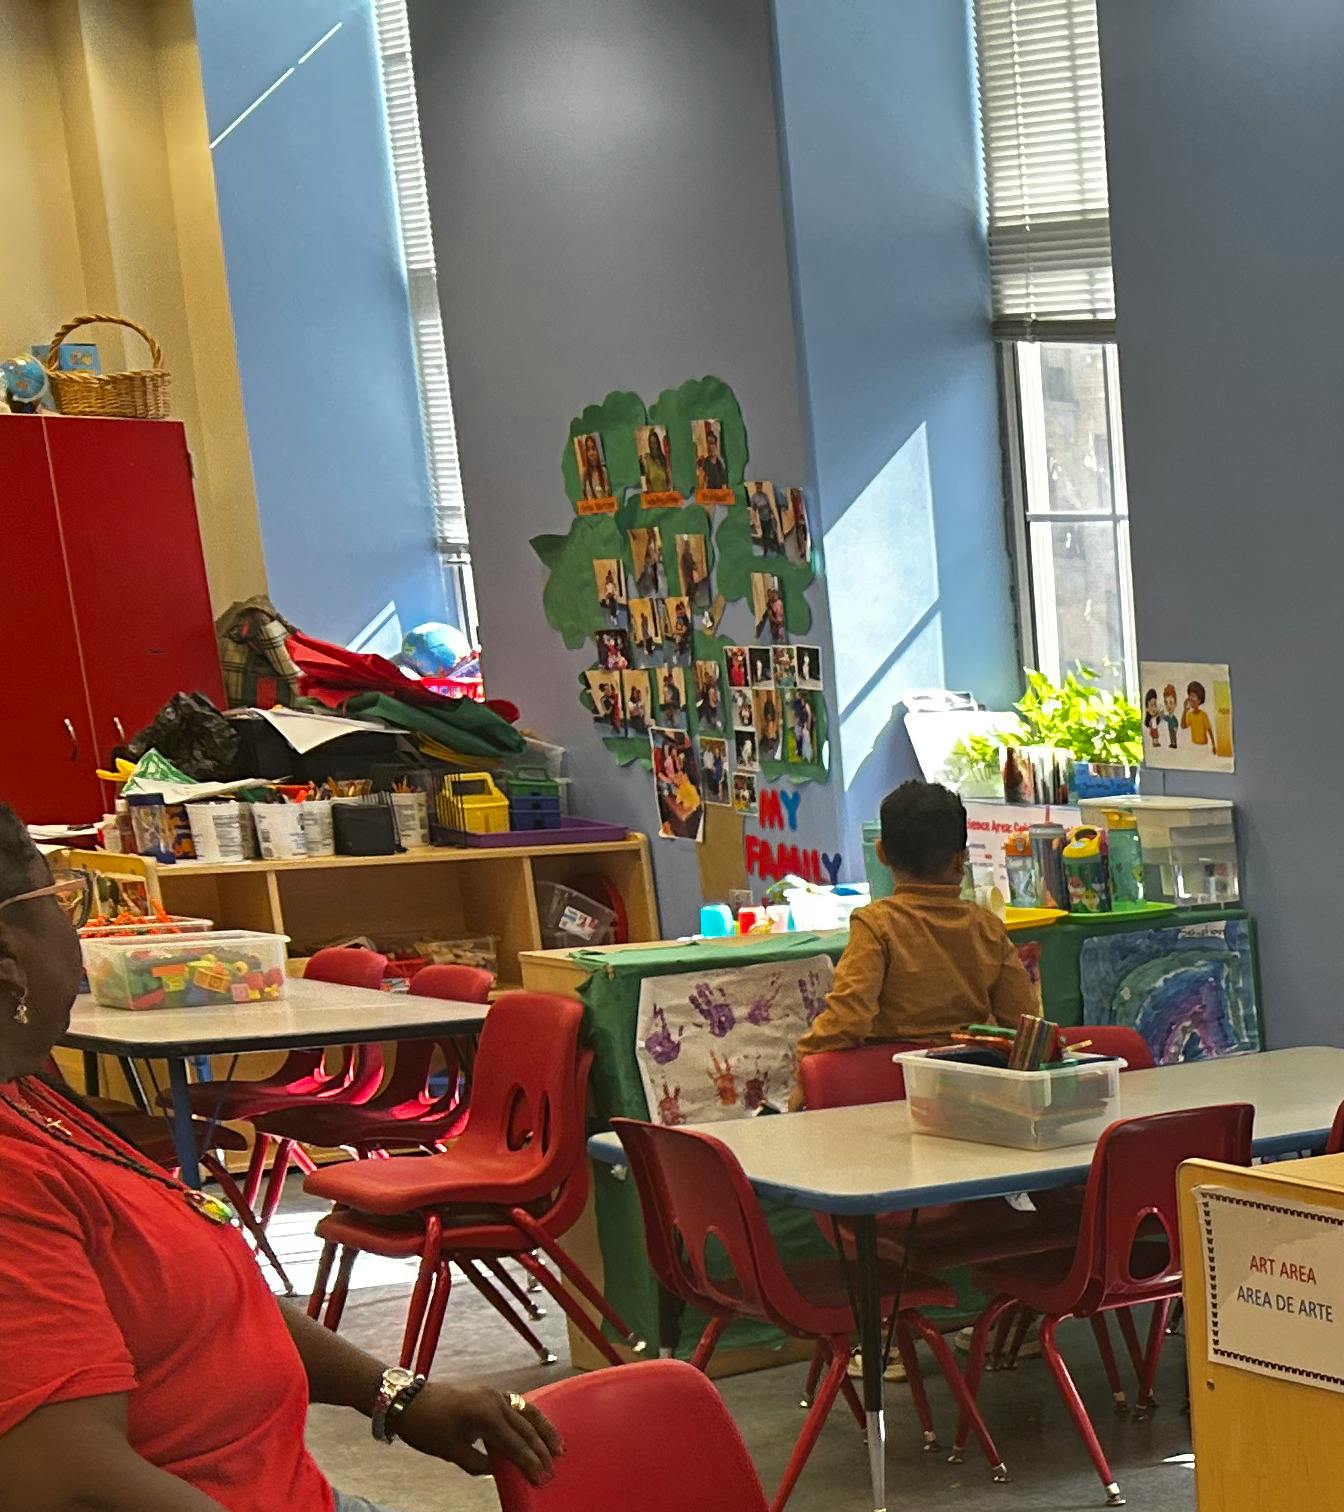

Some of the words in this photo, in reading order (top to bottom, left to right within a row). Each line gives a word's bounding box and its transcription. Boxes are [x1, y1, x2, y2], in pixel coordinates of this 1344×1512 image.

[758, 786, 801, 832] MY
[744, 833, 843, 886] FAMILY
[1249, 1254, 1276, 1277] ART
[1279, 1258, 1318, 1287] AREA
[1236, 1284, 1273, 1309] AREA
[1276, 1292, 1296, 1314] DE
[1298, 1297, 1335, 1324] ARTE
